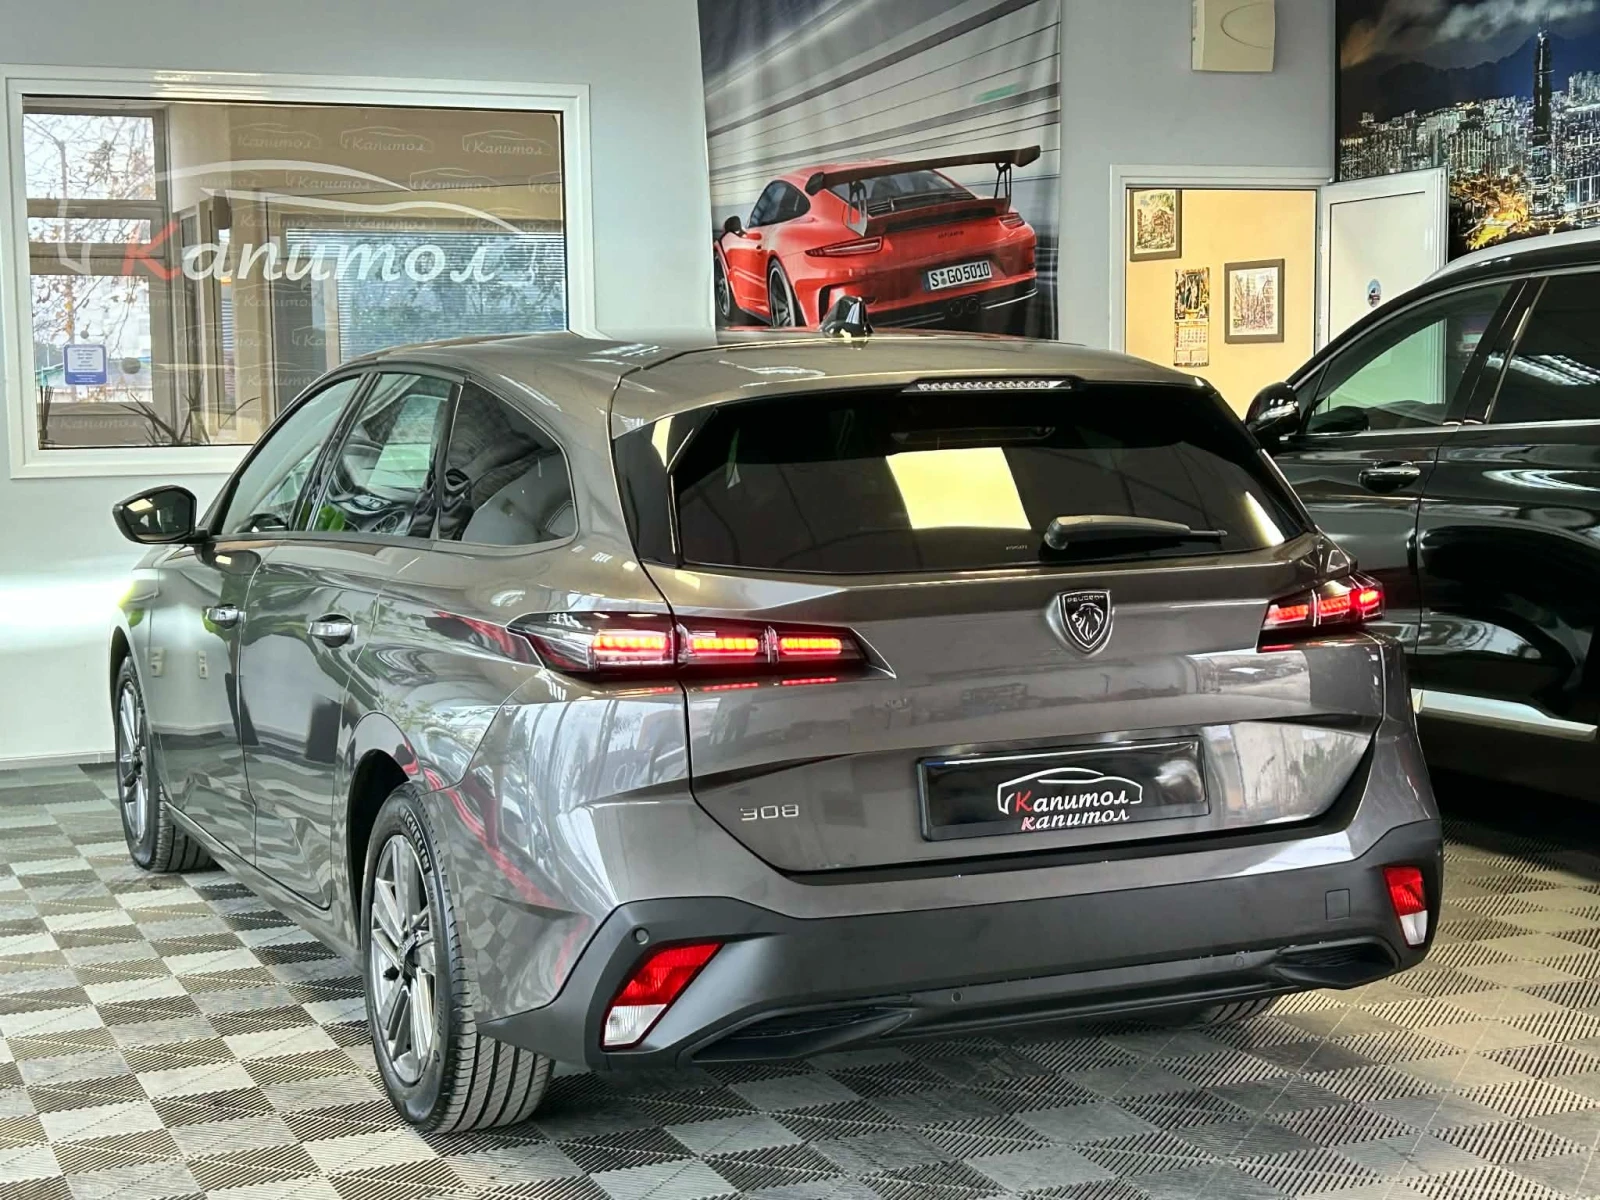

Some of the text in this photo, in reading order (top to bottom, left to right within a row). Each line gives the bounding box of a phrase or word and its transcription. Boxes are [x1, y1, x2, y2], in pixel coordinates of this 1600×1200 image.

[472, 140, 544, 155] Капитол
[121, 220, 496, 283] Капитол
[1015, 789, 1129, 813] Капитол
[740, 803, 800, 822] 308
